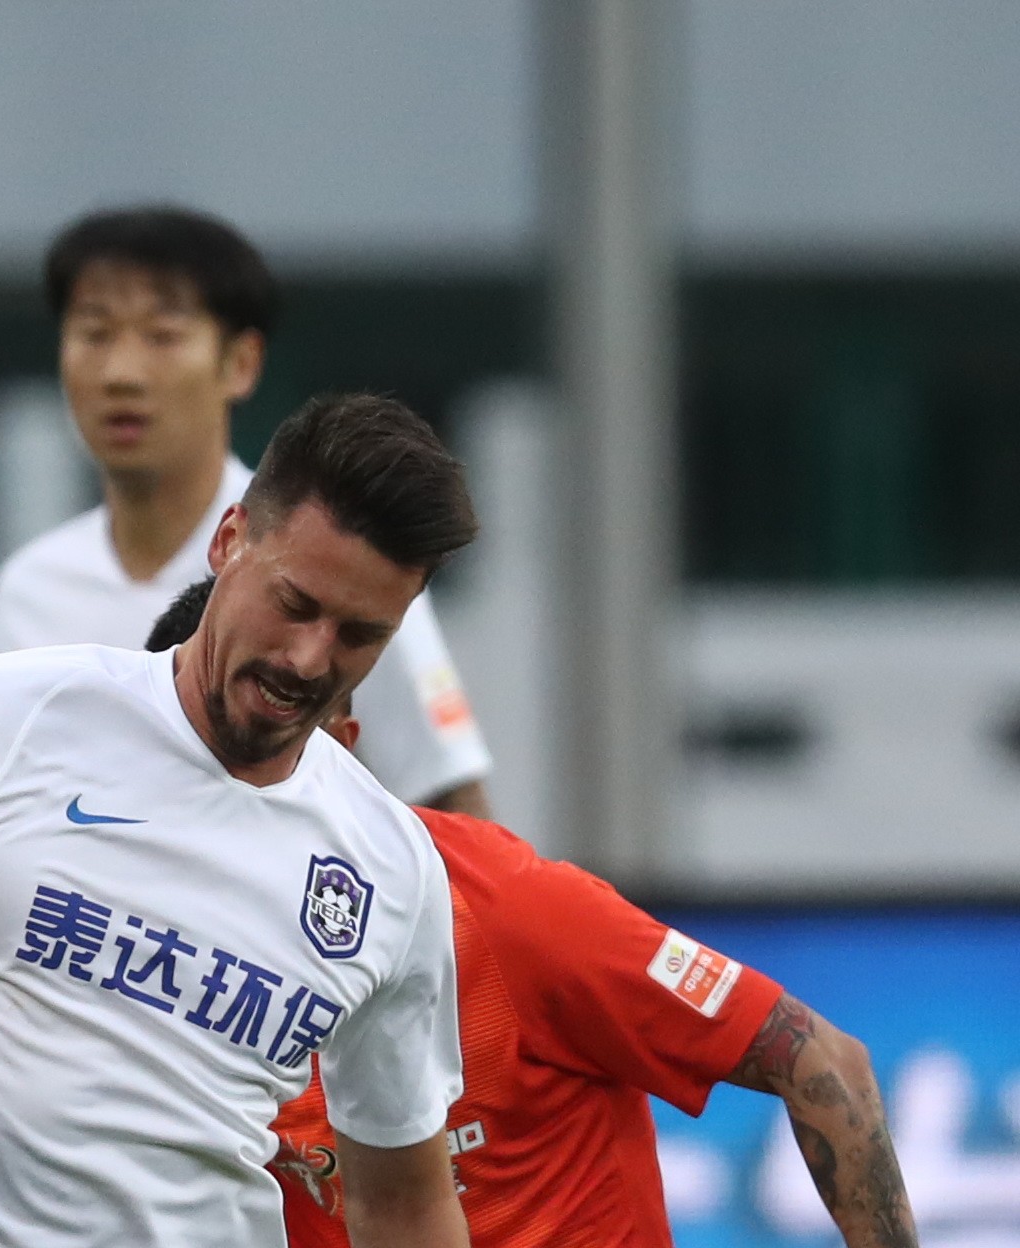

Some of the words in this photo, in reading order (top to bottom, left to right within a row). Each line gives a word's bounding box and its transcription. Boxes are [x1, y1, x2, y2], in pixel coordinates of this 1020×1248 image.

[307, 891, 359, 935] TEDA
[16, 885, 343, 1068] 泰达环保
